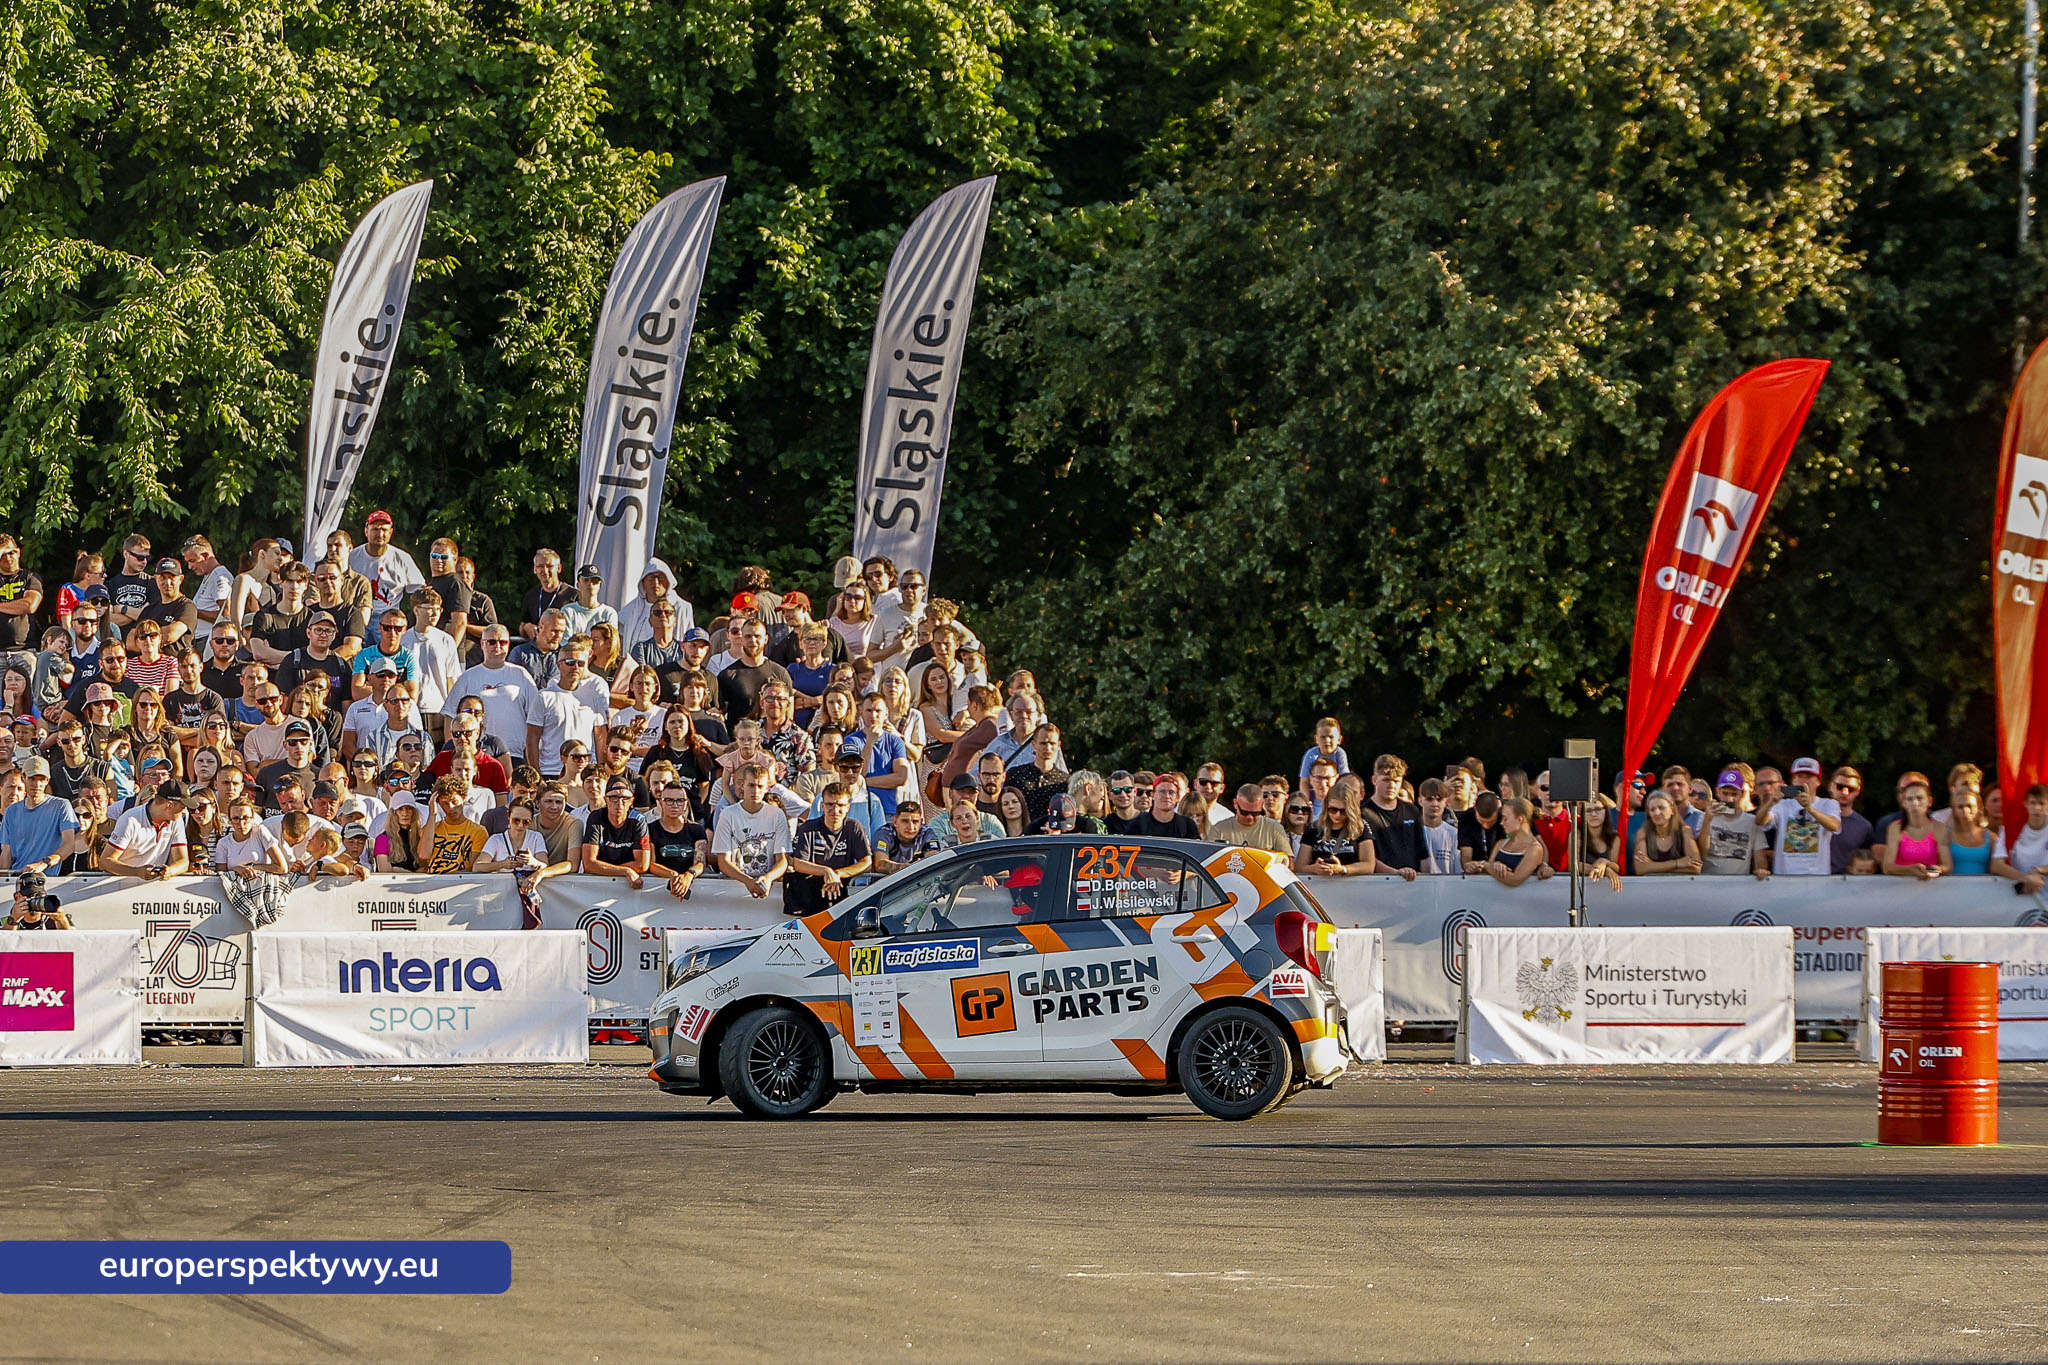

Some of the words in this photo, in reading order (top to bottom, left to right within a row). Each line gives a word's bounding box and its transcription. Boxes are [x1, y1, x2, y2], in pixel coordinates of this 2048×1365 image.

[588, 298, 681, 531] Śląskie.
[863, 299, 955, 534] Śląskie.
[1076, 845, 1143, 879] 237
[1092, 878, 1157, 892] D.Boncela
[132, 902, 180, 915] STADION
[183, 899, 222, 919] ŚLĄSKI
[357, 901, 405, 914] STADION
[408, 899, 447, 917] ŚLĄSKI
[1092, 894, 1174, 910] J.Wasilewski
[773, 932, 802, 941] EVEREST
[146, 920, 208, 988] 70
[852, 946, 881, 976] 237
[887, 946, 974, 967] #rajdslaska
[2, 977, 30, 988] RMF
[146, 976, 166, 989] LAT
[339, 952, 502, 994] interia
[1017, 955, 1160, 997] GARDEN
[1585, 964, 1707, 982] Ministerstwo
[146, 992, 196, 1005] LEGENDY
[960, 985, 1005, 1022] GP
[1585, 989, 1647, 1009] Sportu
[1652, 989, 1657, 1006] i
[1662, 989, 1748, 1010] Turystyki
[369, 1006, 476, 1032] SPORT
[1918, 1046, 1963, 1058] ORLEN
[1918, 1059, 1936, 1068] OIL
